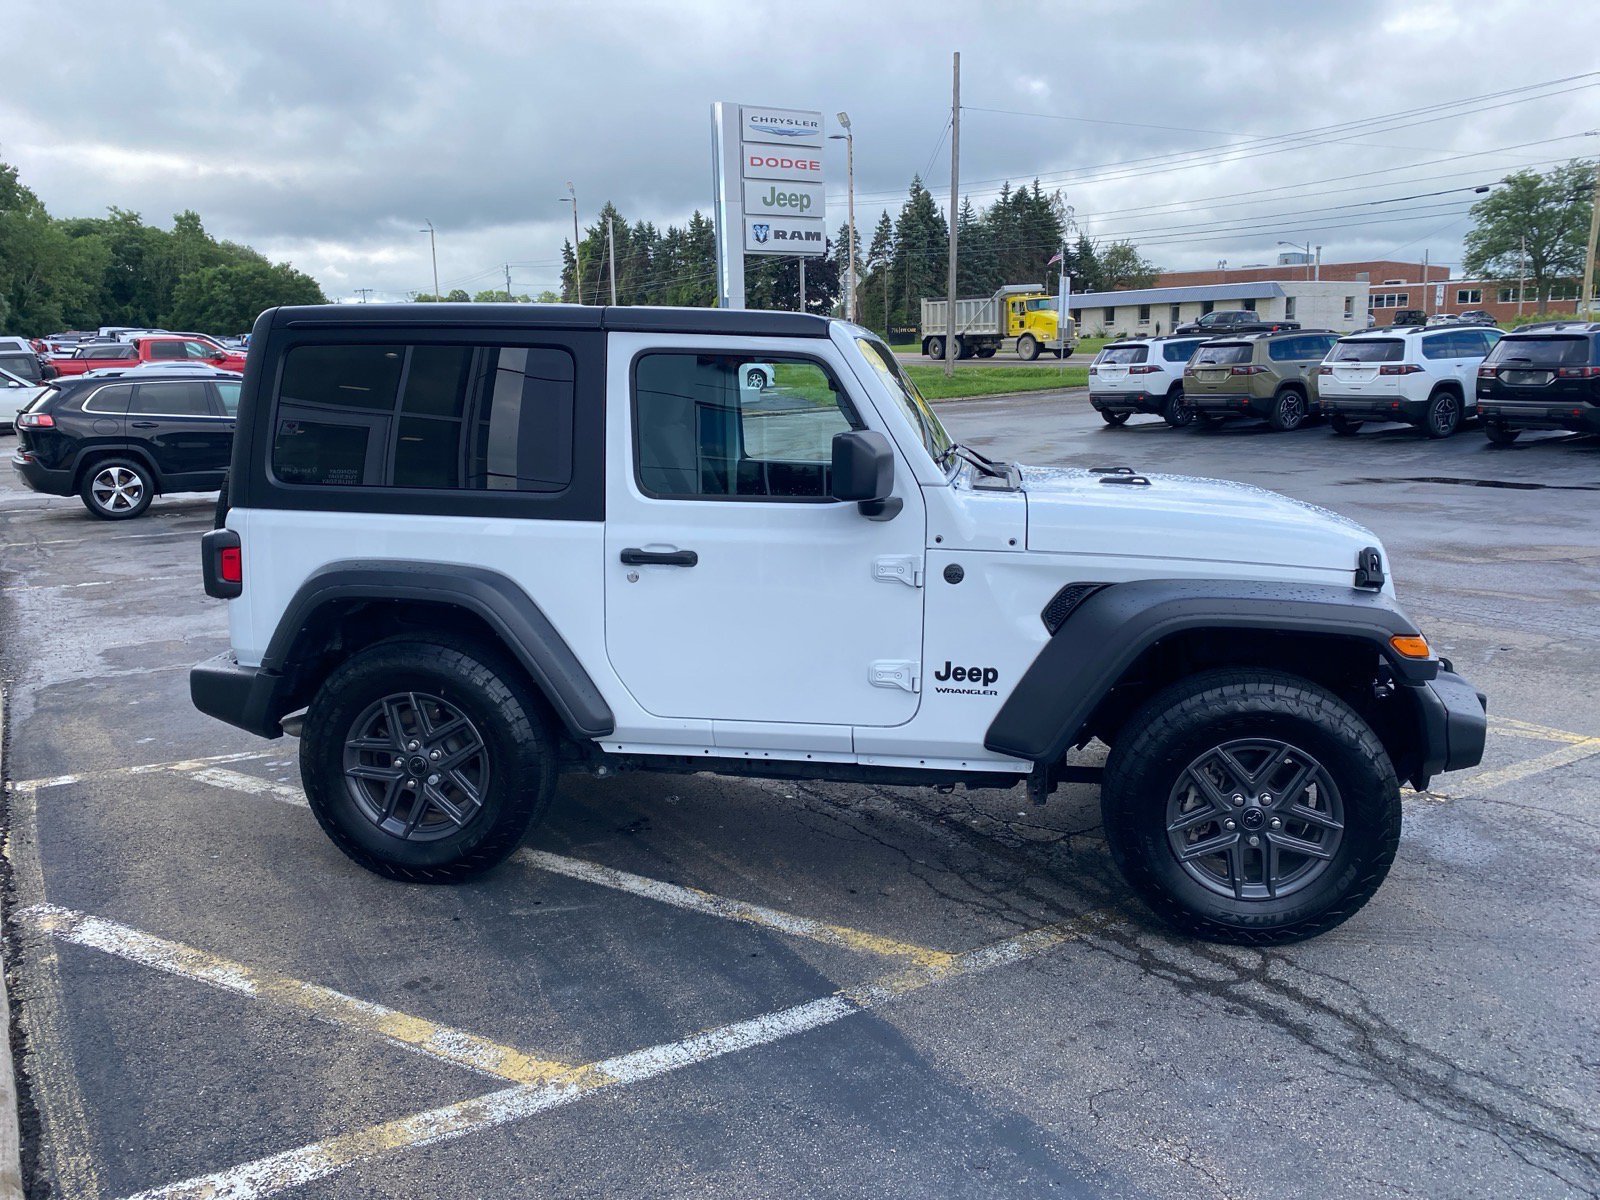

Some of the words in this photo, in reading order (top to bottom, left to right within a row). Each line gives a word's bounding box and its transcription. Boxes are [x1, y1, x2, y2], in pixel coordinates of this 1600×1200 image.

[750, 115, 818, 128] CHRYSLER
[750, 156, 820, 171] DODGE
[762, 186, 811, 212] Jeep
[773, 229, 822, 241] RAM
[934, 661, 999, 687] Jeep
[935, 687, 998, 696] WRANGLER
